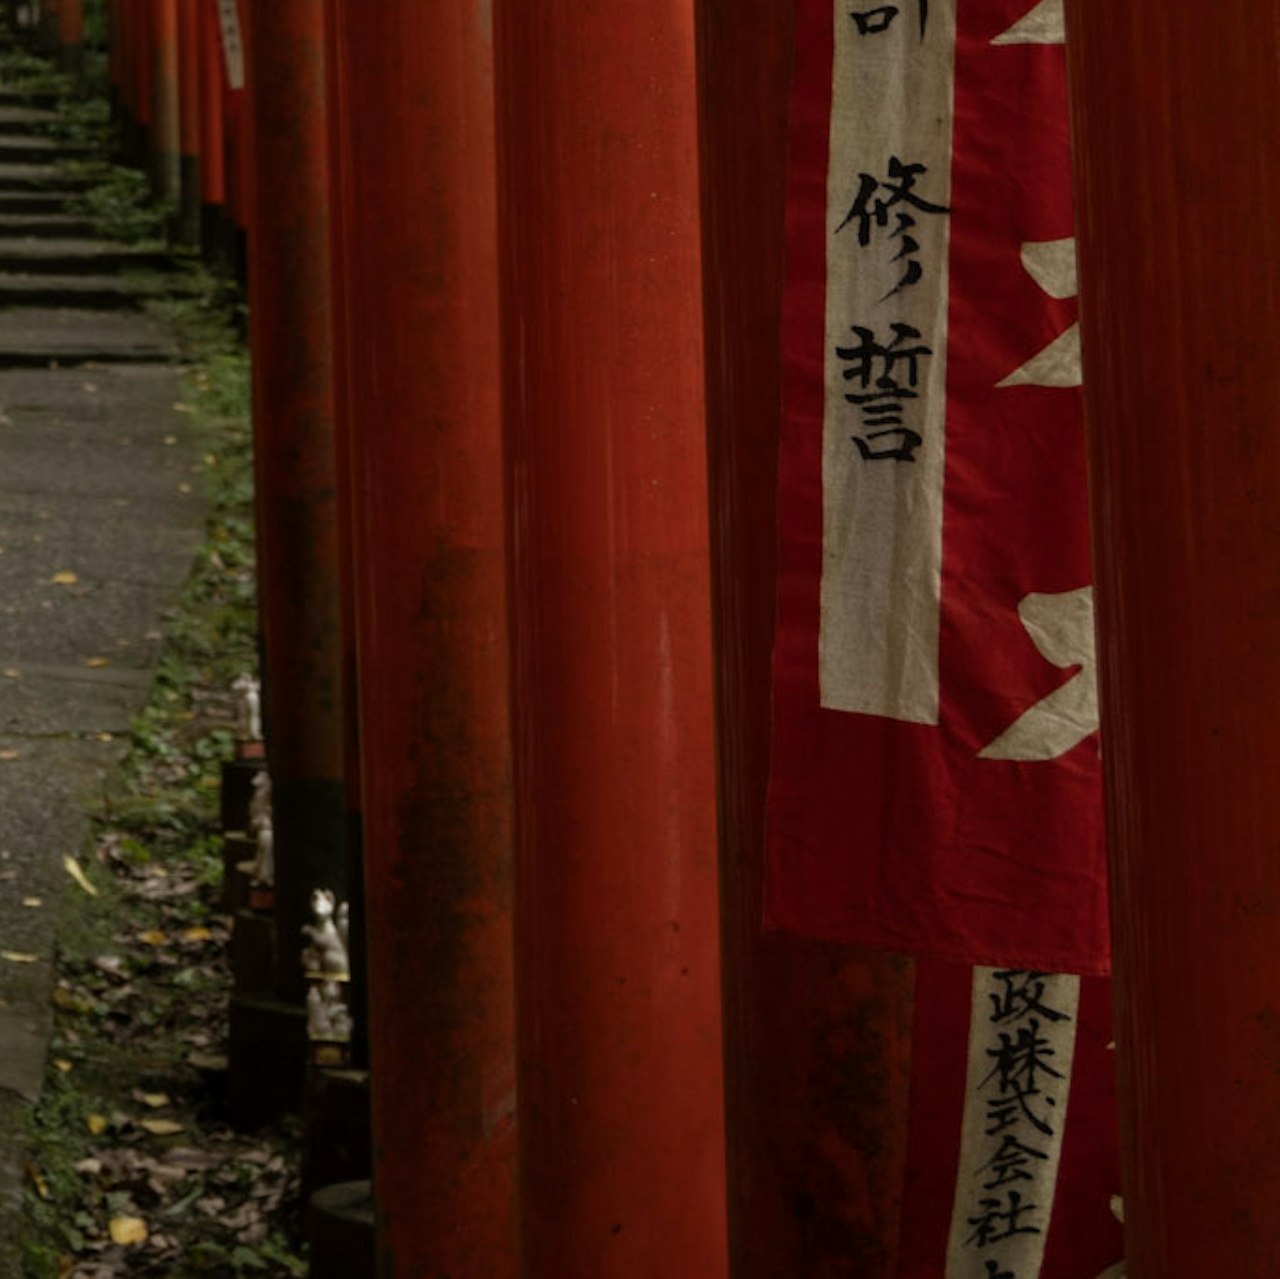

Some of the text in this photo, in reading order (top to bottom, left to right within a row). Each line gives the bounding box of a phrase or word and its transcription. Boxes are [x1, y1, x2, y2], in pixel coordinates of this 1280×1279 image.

[964, 969, 1072, 1279] 政株式会社
